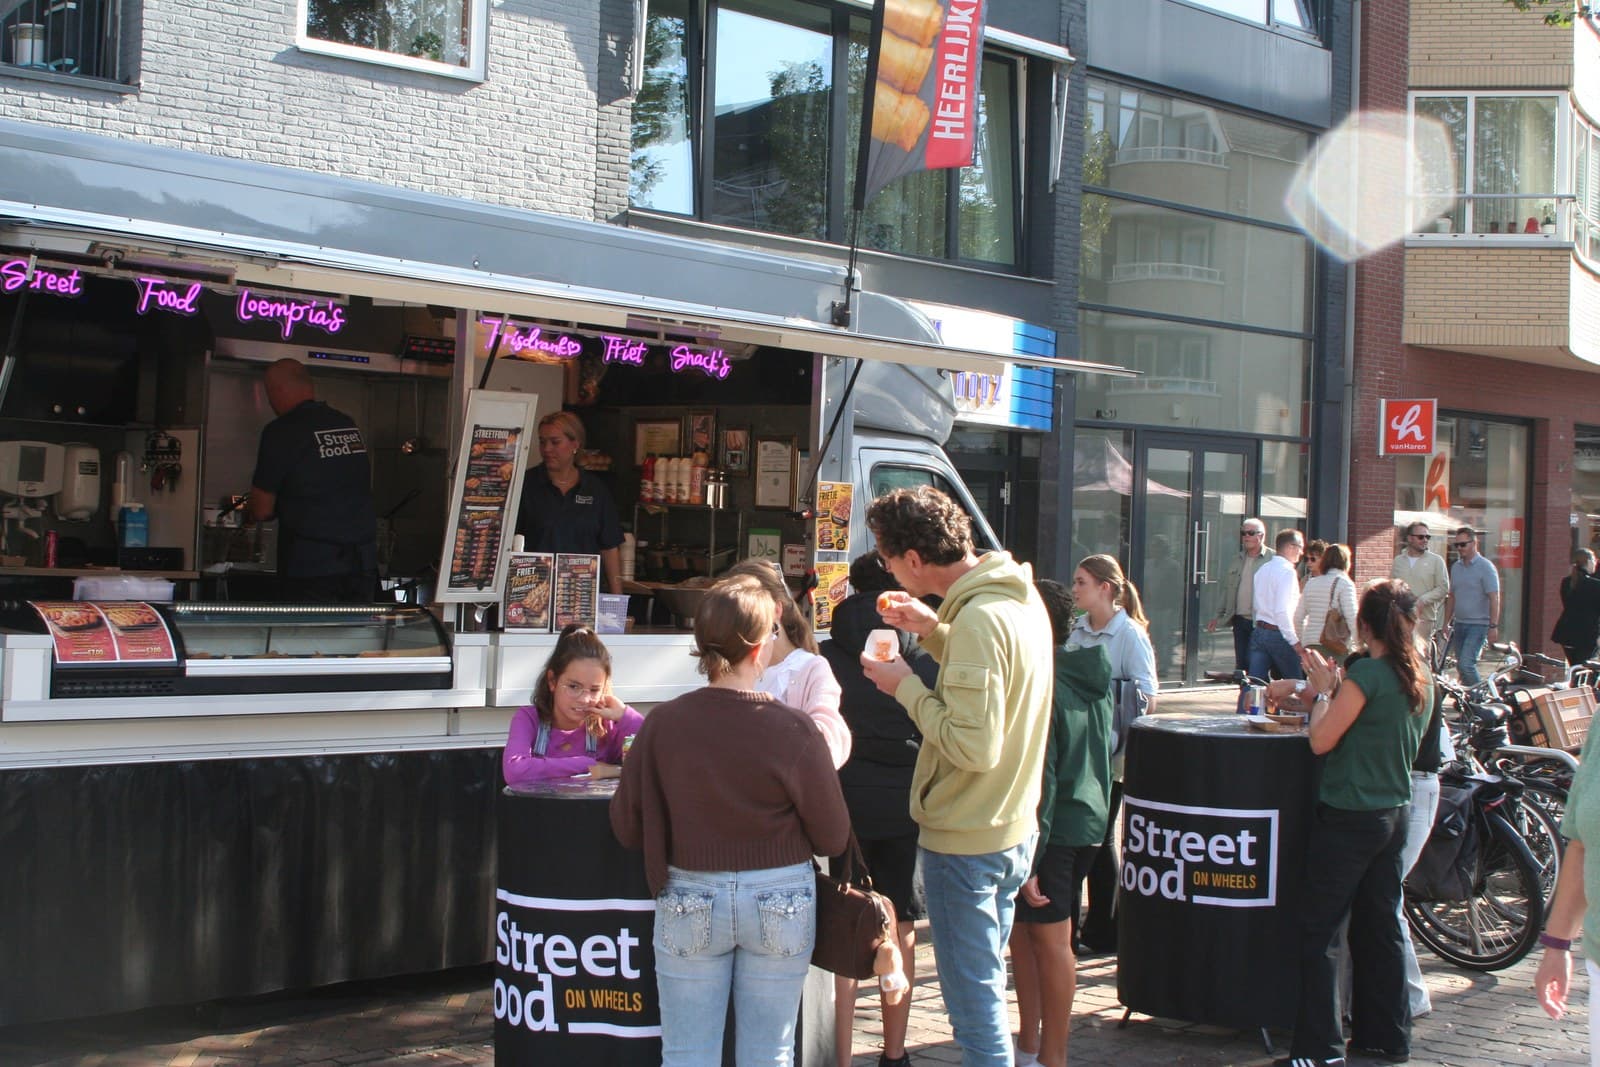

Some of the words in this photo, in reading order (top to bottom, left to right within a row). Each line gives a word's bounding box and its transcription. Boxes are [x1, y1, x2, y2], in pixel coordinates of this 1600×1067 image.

[933, 0, 980, 139] HEERLIJK
[0, 260, 81, 294] Sreet
[139, 277, 201, 312] Food
[320, 443, 352, 458] food
[323, 433, 360, 446] Street
[516, 566, 536, 577] FRIET
[1129, 813, 1257, 866] Street
[1193, 871, 1209, 886] ON
[1212, 873, 1257, 890] WHEELS
[497, 912, 641, 980] Street
[494, 973, 560, 1033] ood
[565, 988, 585, 1009] ON
[590, 988, 643, 1013] WHEELS
